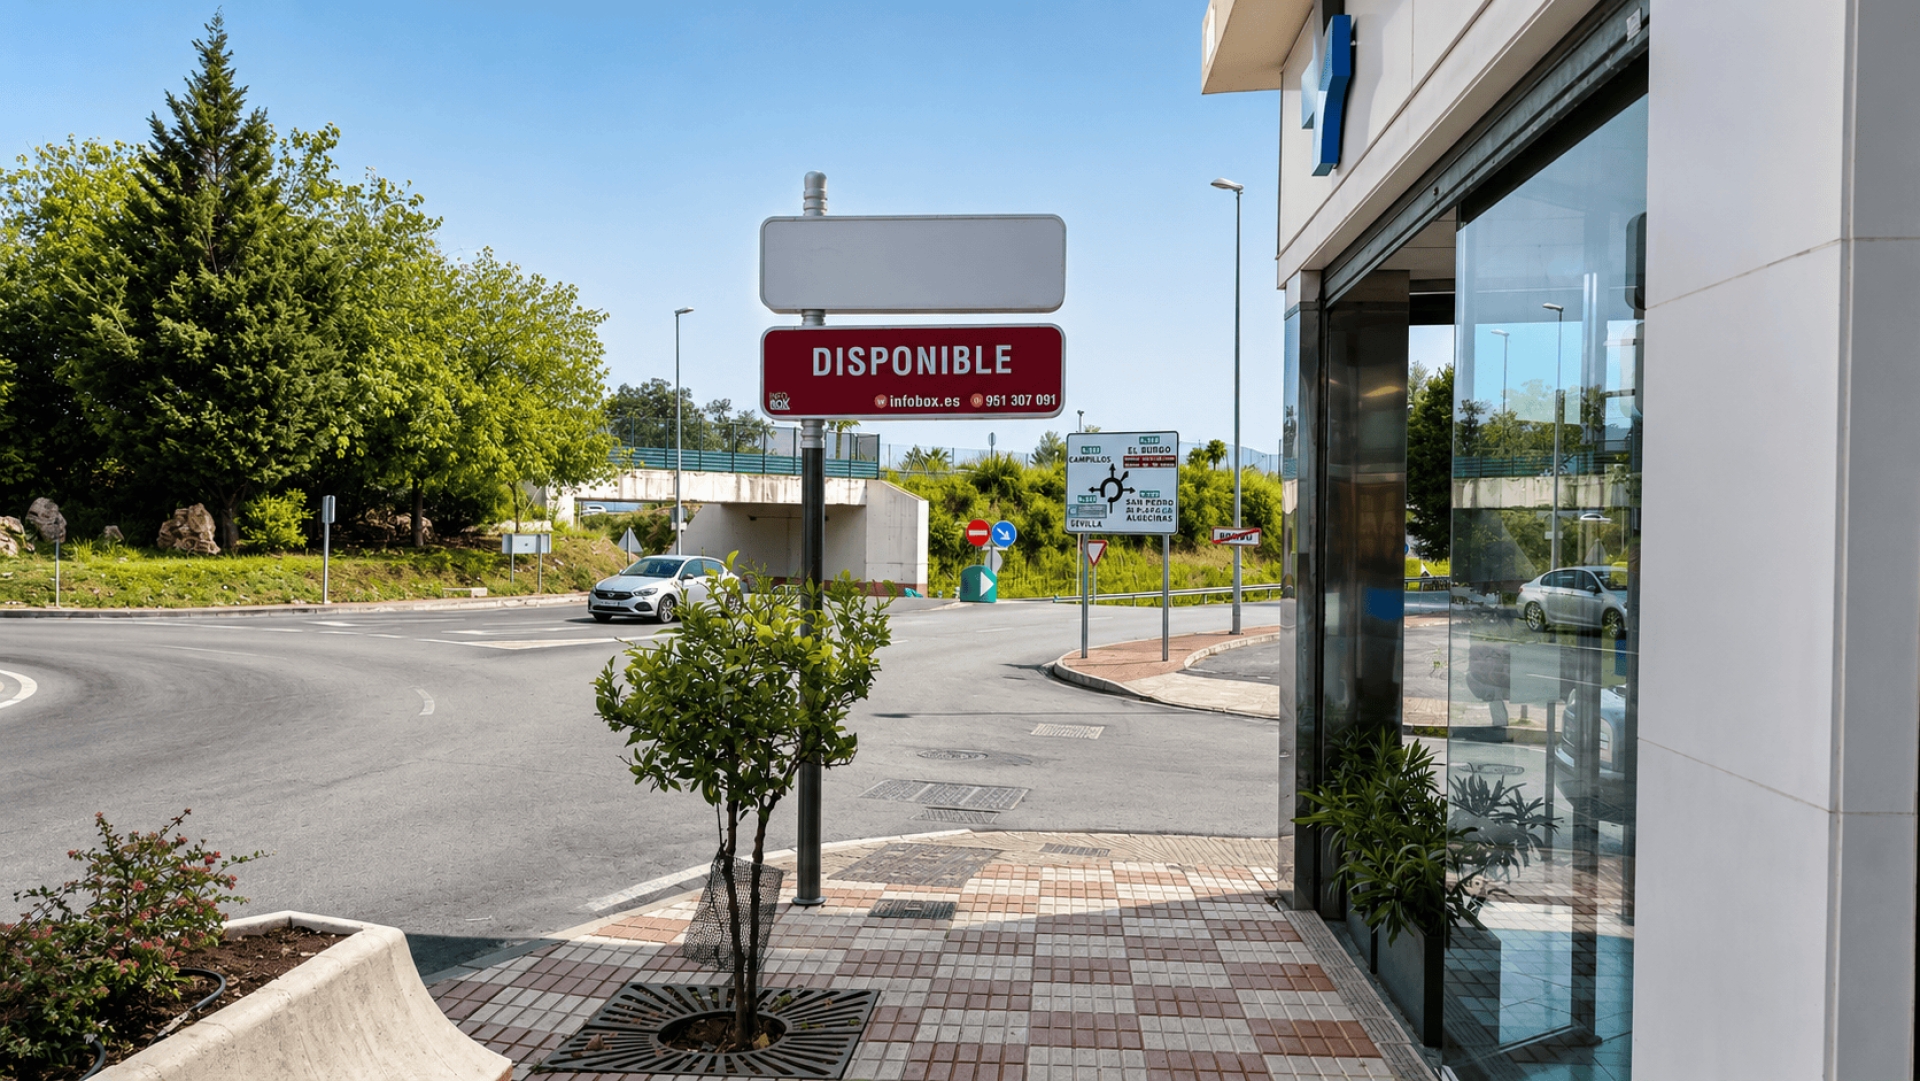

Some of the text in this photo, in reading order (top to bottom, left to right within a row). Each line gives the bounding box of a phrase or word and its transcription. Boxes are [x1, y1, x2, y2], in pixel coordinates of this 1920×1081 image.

[812, 344, 1012, 377] DISPONIBLE
[890, 394, 960, 408] infobox.es
[985, 393, 1056, 407] 951 307 091
[1068, 455, 1112, 463] CAMPILLOS
